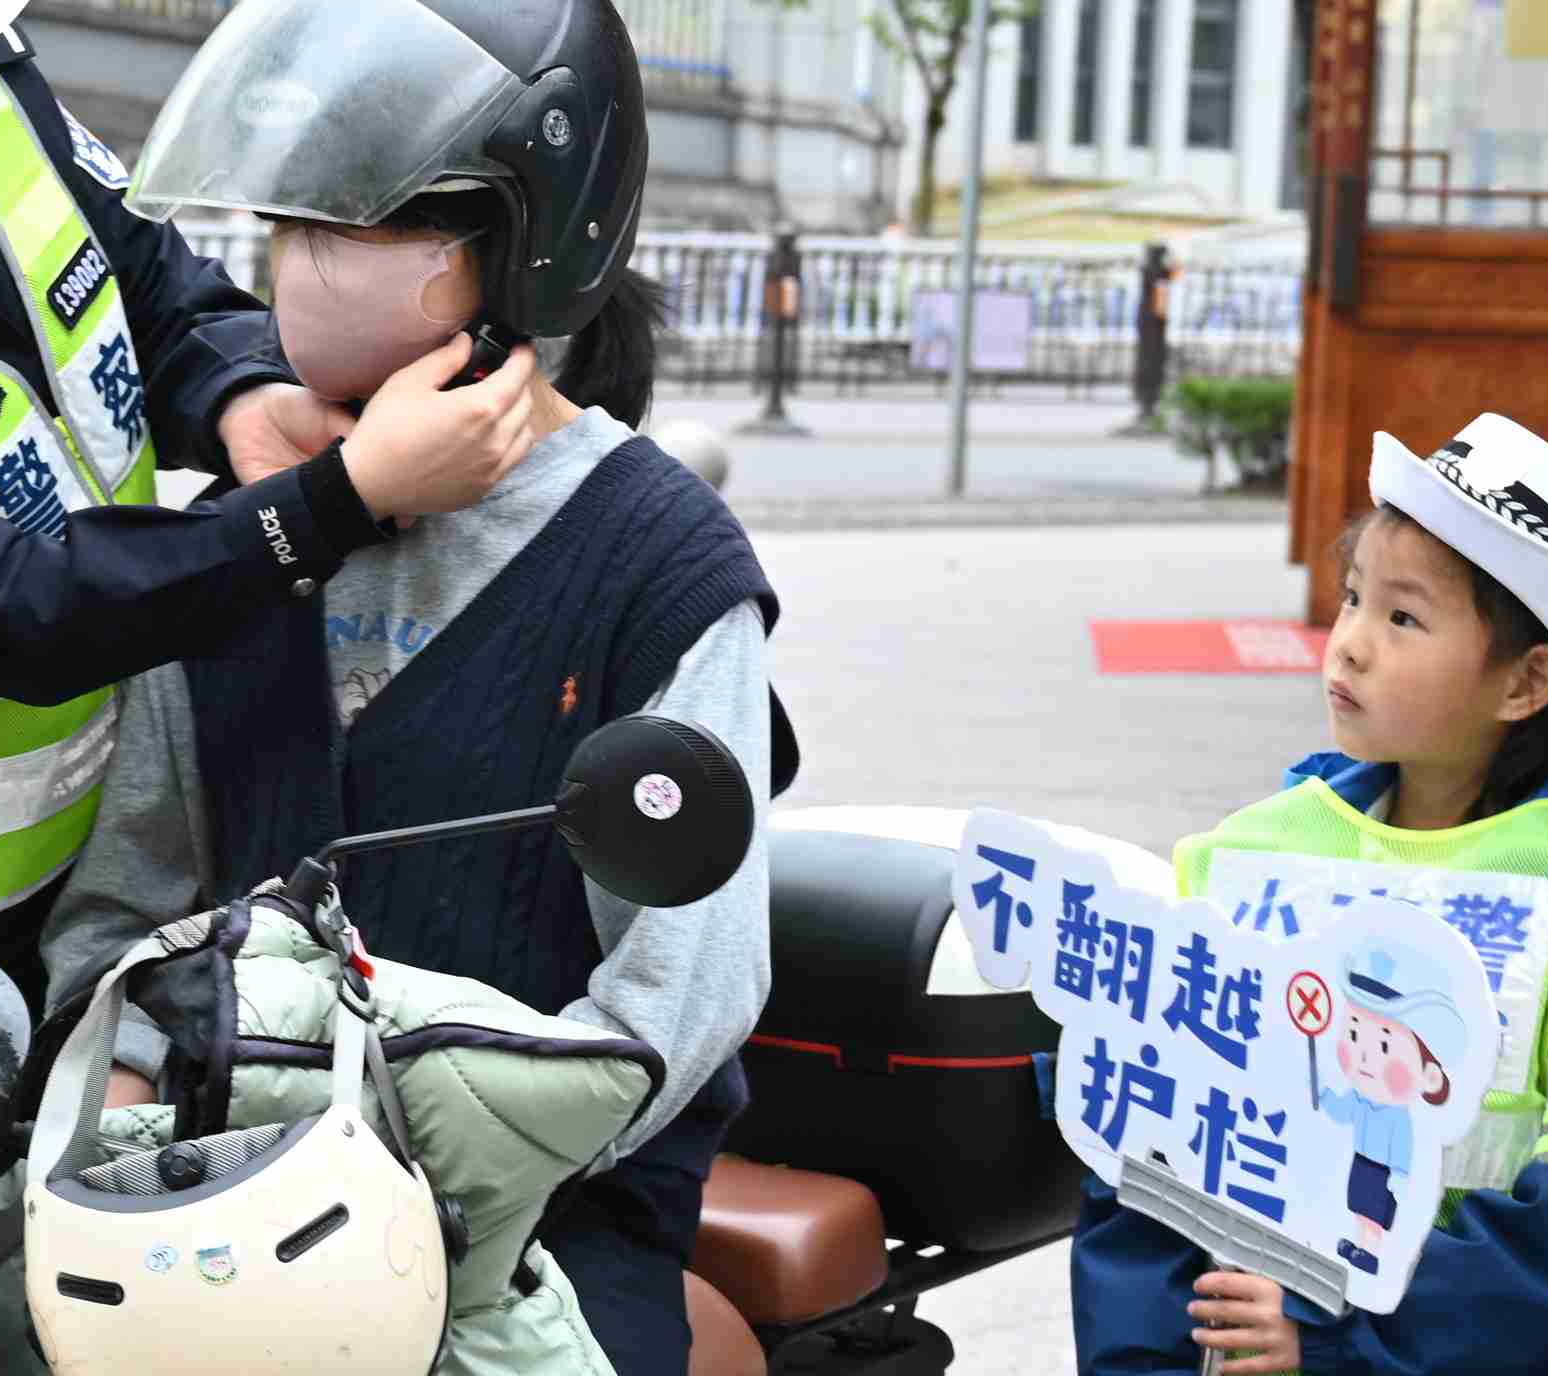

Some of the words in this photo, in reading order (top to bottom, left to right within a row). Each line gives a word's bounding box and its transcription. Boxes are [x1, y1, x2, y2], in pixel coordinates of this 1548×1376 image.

[257, 506, 299, 564] POLICE
[970, 843, 1264, 1071] 不翻越
[1080, 1036, 1288, 1224] 护栏
